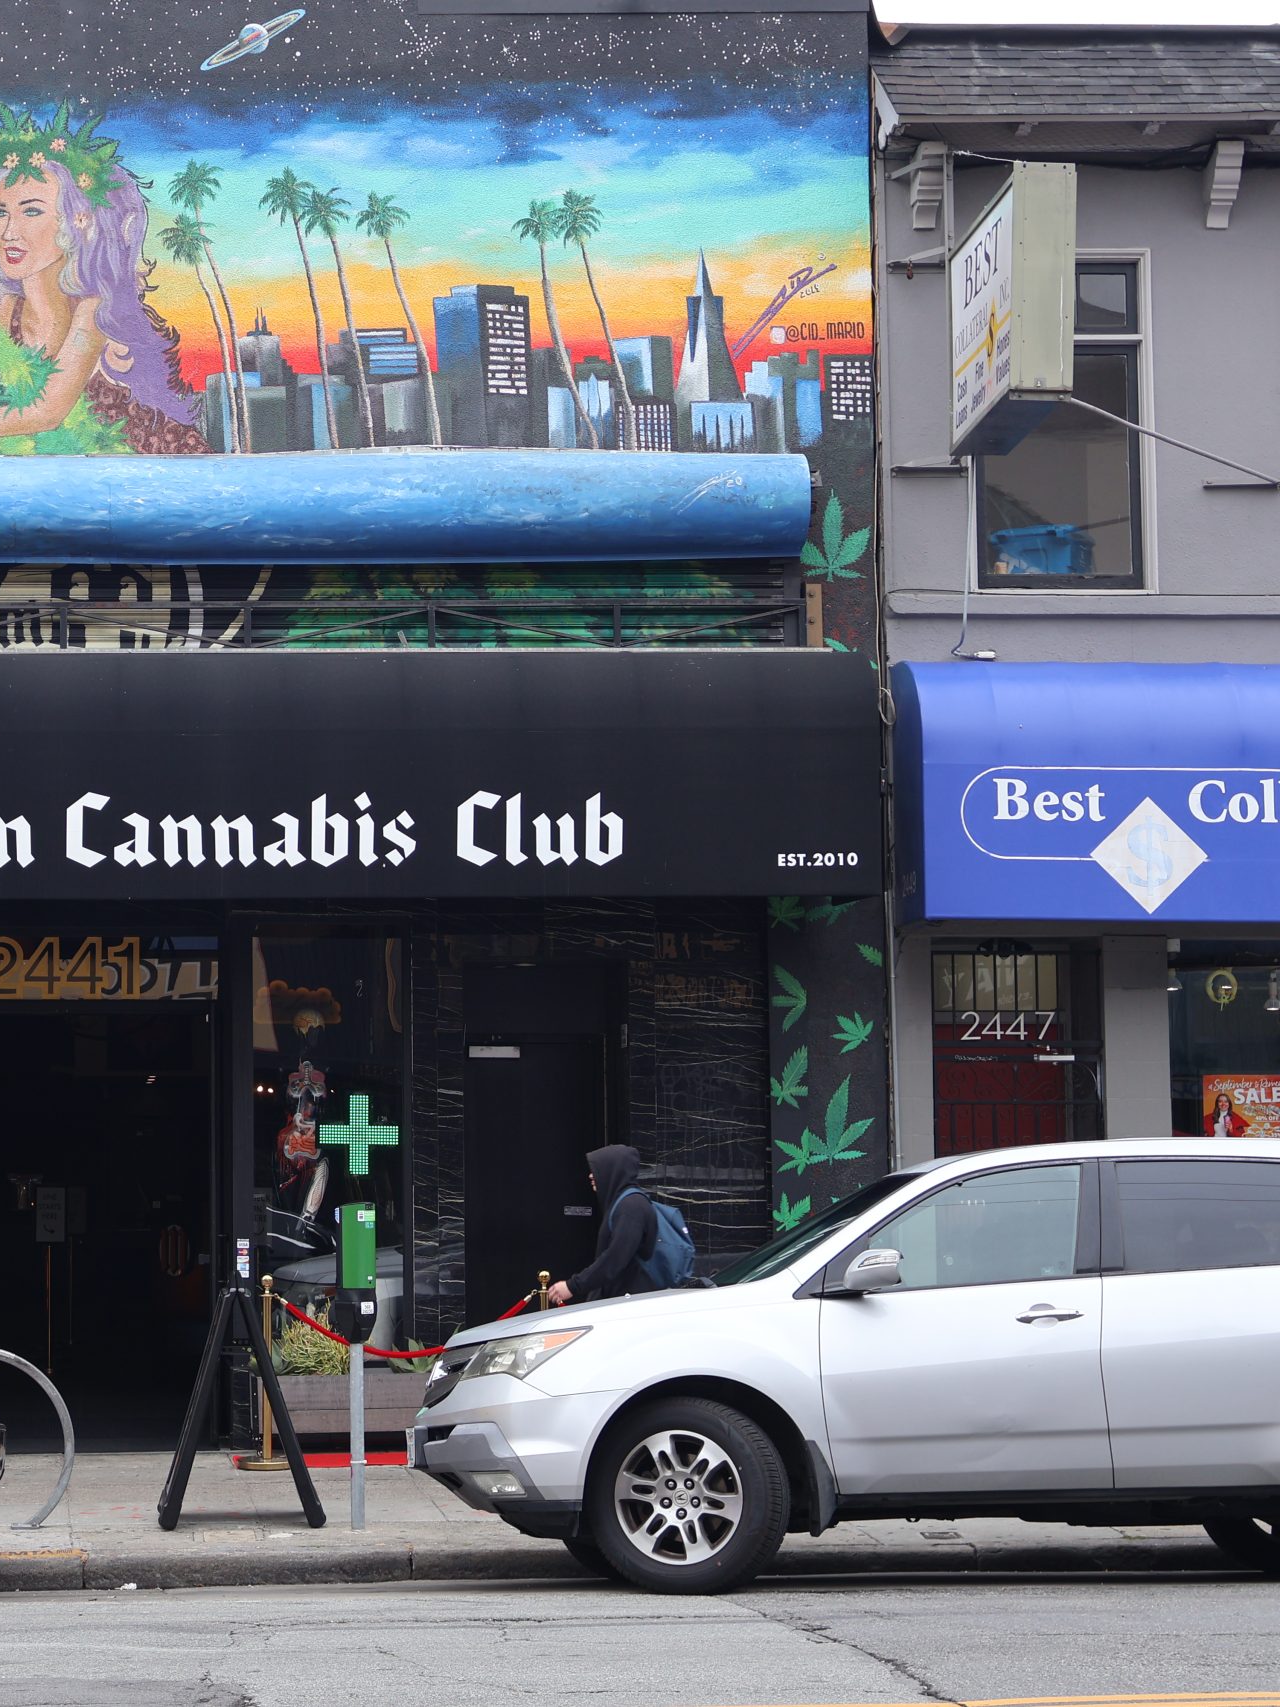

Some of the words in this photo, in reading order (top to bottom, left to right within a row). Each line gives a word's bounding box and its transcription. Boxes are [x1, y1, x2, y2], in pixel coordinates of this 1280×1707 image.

[964, 217, 1002, 309] BEST
[786, 322, 865, 342] @CID_MARIO
[957, 376, 968, 402] Cash
[975, 361, 984, 383] Fine
[956, 404, 968, 429] Loans
[993, 778, 1106, 822] Best
[1188, 778, 1280, 824] Col
[66, 792, 417, 869] Cannabis
[457, 790, 624, 867] Club
[777, 852, 859, 867] EST.2010
[960, 1011, 1056, 1041] 2447
[1213, 1078, 1252, 1093] September
[1233, 1087, 1280, 1105] SALE
